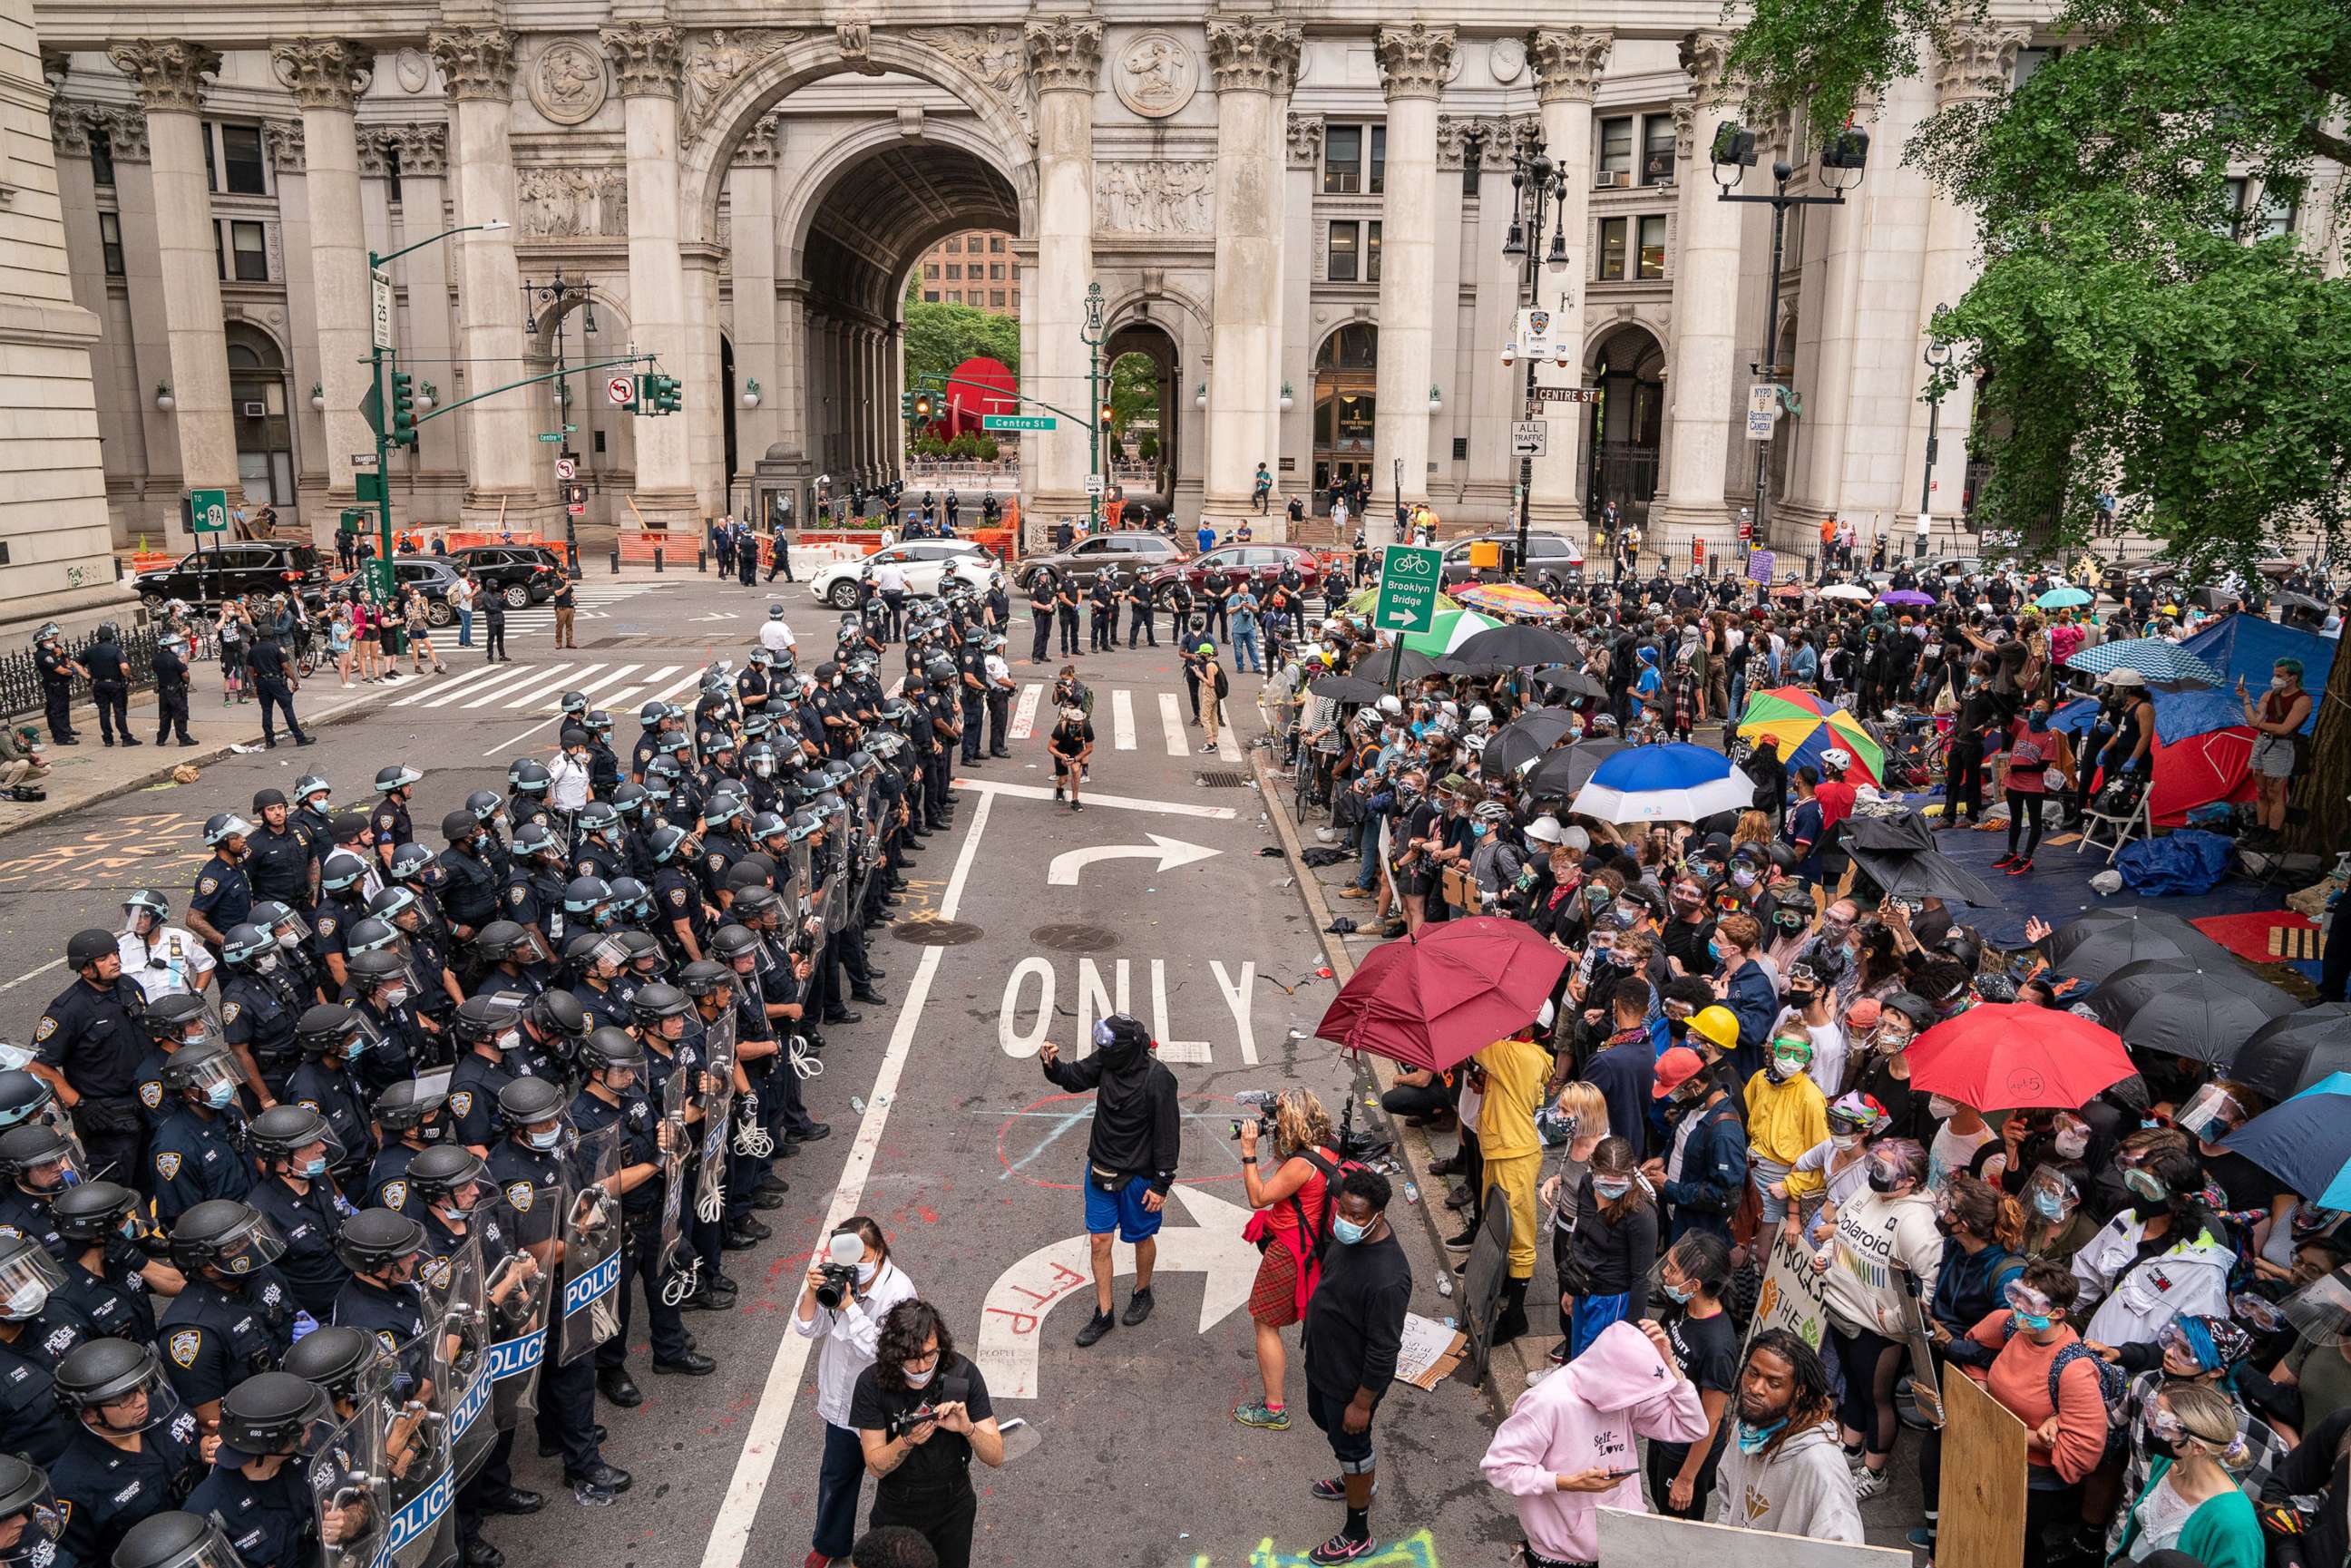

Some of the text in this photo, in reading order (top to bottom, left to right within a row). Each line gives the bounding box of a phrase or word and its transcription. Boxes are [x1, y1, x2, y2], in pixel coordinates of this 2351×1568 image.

[377, 304, 387, 323] 25
[1539, 390, 1595, 402] CENTRE ST
[1754, 388, 1771, 398] NYPD
[1353, 409, 1361, 420] 1
[1749, 410, 1773, 421] SECURITY
[995, 419, 1046, 428] Centre St
[1519, 424, 1539, 433] ALL
[1749, 421, 1771, 431] CAMERA
[1515, 433, 1543, 442] TRAFFIC
[194, 494, 202, 502] TO
[210, 509, 222, 522] 9A
[1387, 580, 1430, 594] Brooklyn
[1391, 594, 1422, 607] Bridge
[999, 957, 1259, 1065] ONLY
[1776, 1287, 1804, 1336] THE
[44, 1325, 75, 1351] POLICE
[1594, 1431, 1618, 1447] Self-
